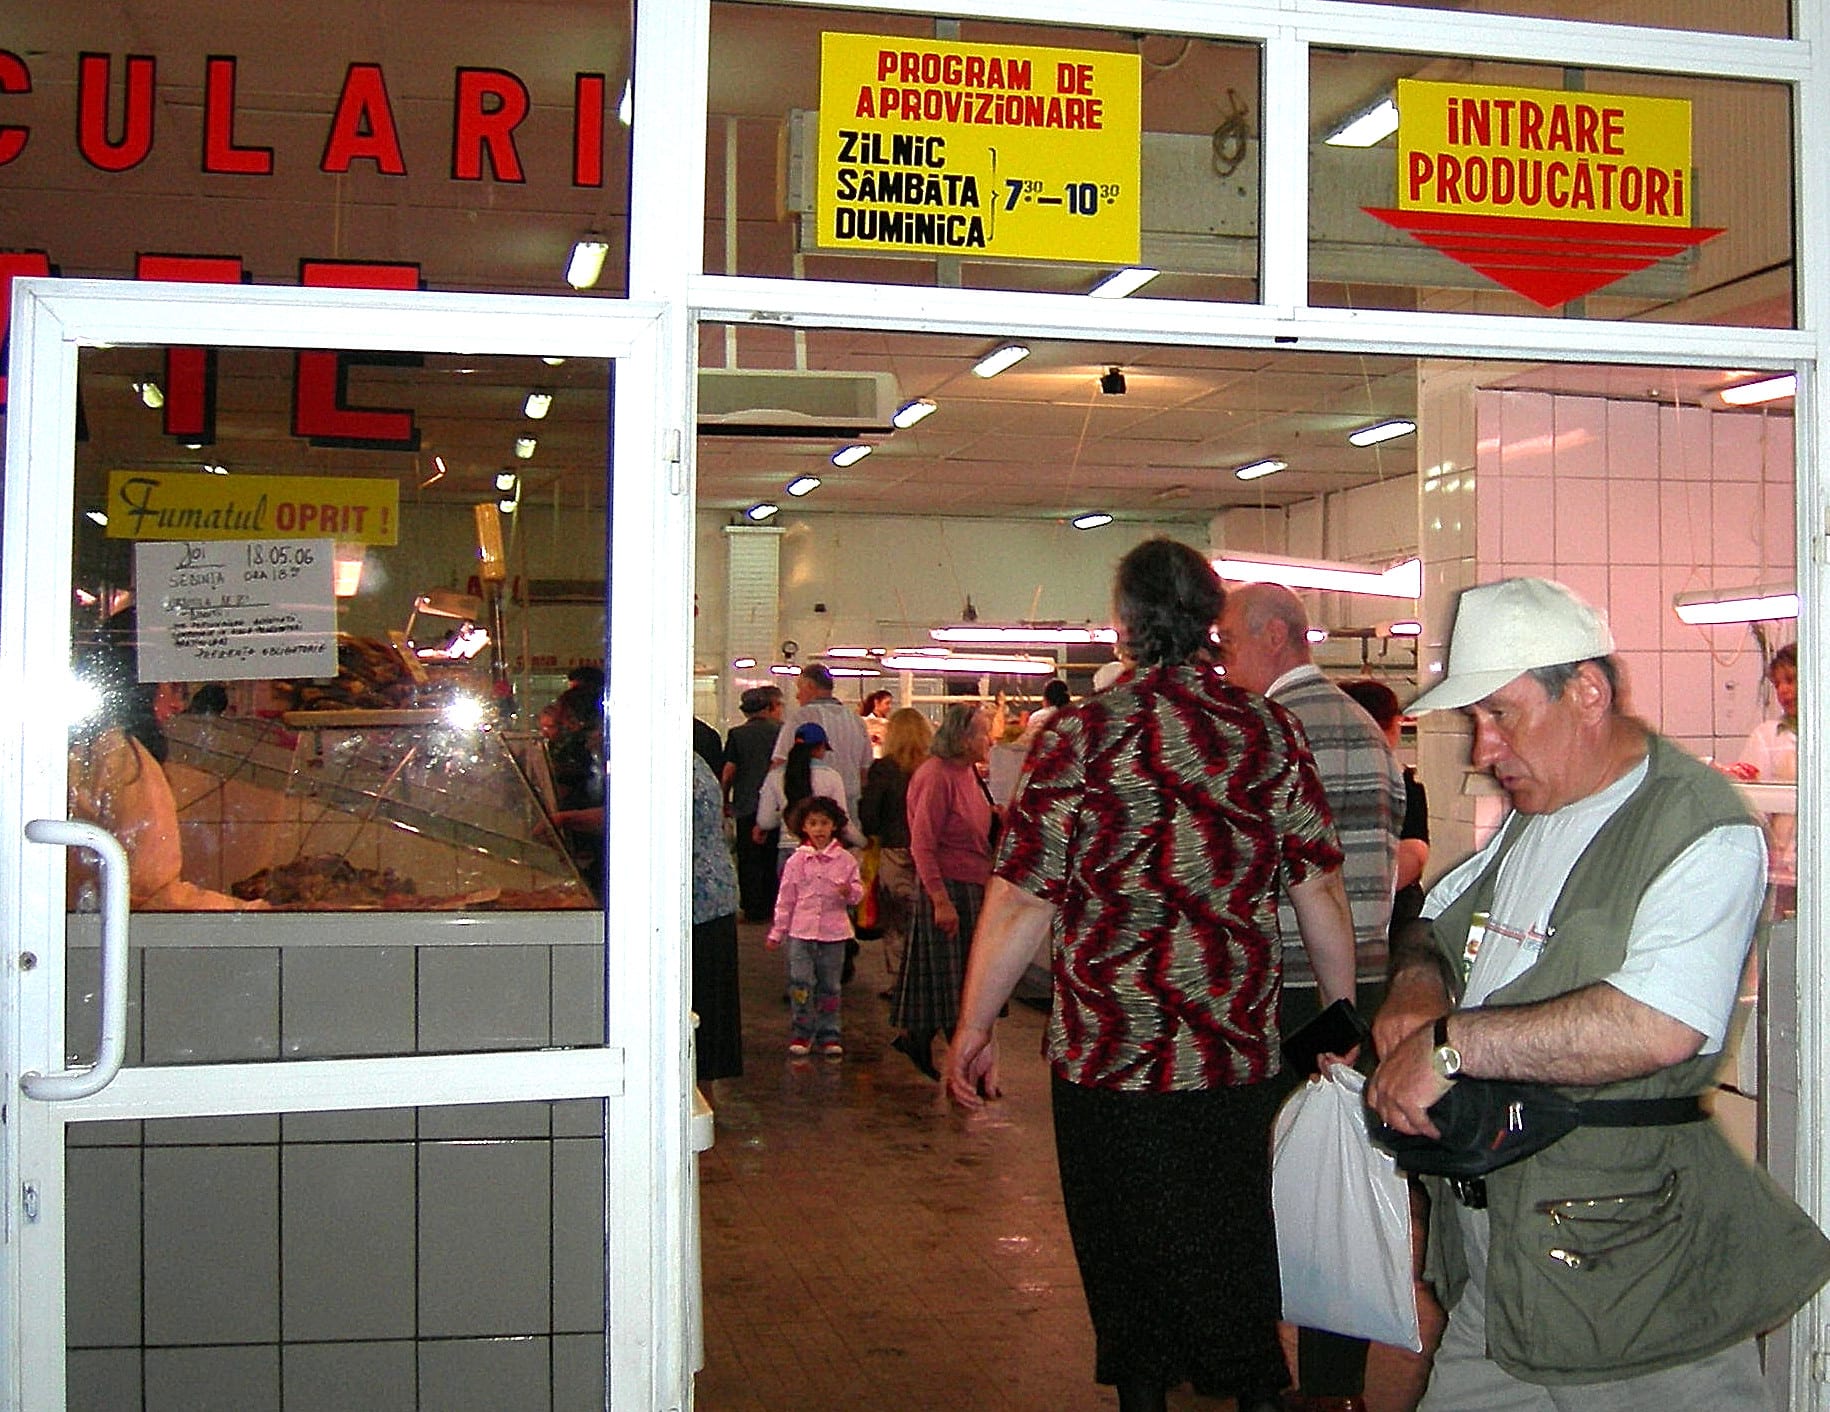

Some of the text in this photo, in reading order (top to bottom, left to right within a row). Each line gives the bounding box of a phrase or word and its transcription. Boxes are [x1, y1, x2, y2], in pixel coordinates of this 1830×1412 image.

[877, 51, 1094, 95] PROGRAM DE
[120, 478, 267, 534] Fumatul
[276, 502, 368, 534] OPRIT
